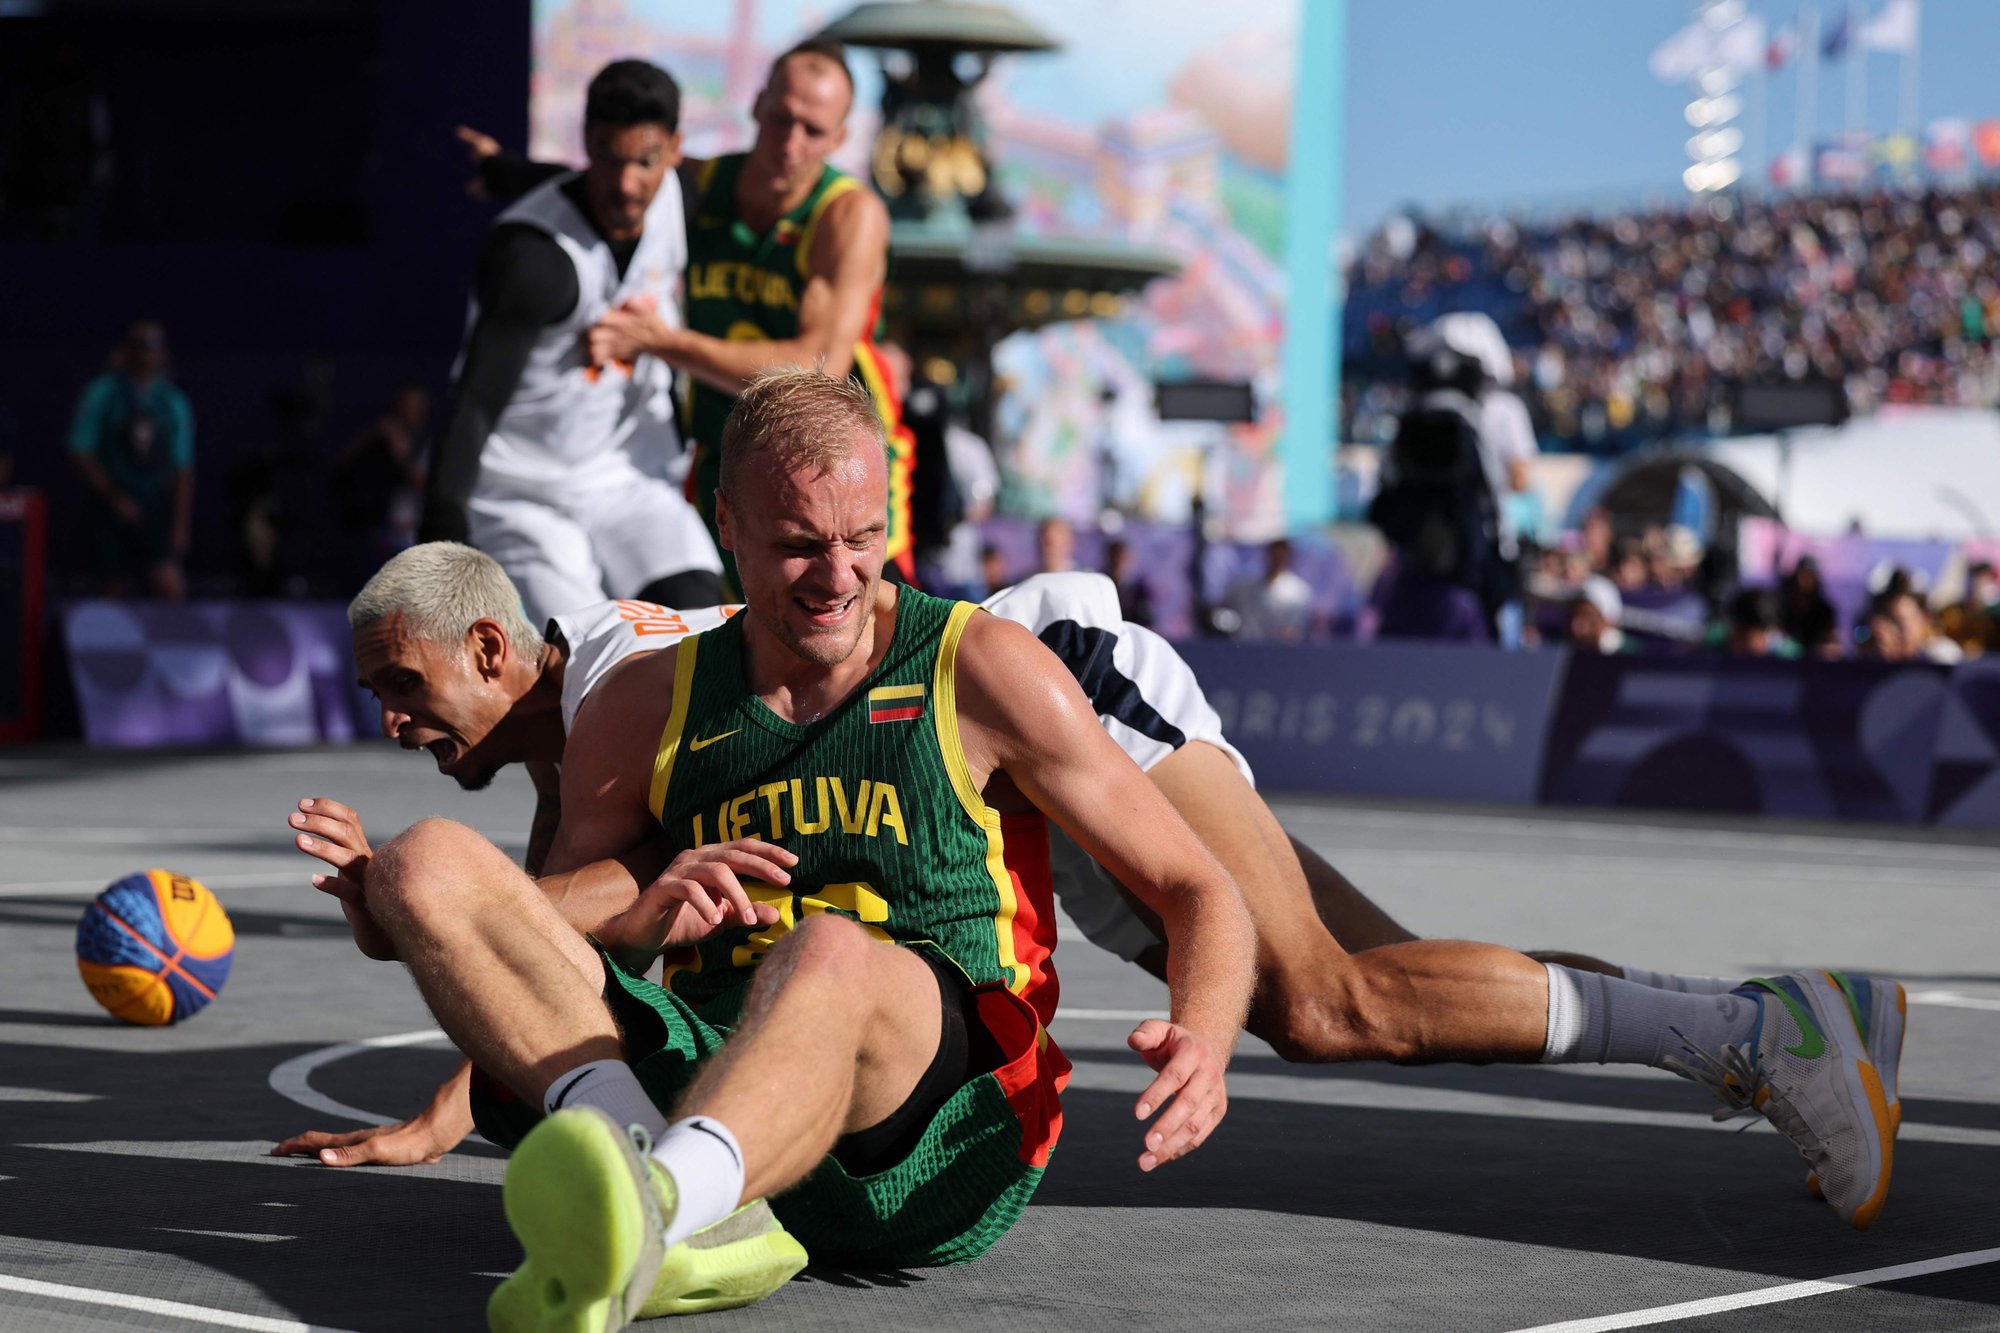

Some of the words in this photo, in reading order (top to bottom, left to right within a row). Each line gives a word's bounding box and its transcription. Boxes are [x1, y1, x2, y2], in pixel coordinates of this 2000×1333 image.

[1208, 690, 1337, 744] ARIS
[1350, 694, 1516, 750] 2024
[692, 777, 909, 849] LIETUVA
